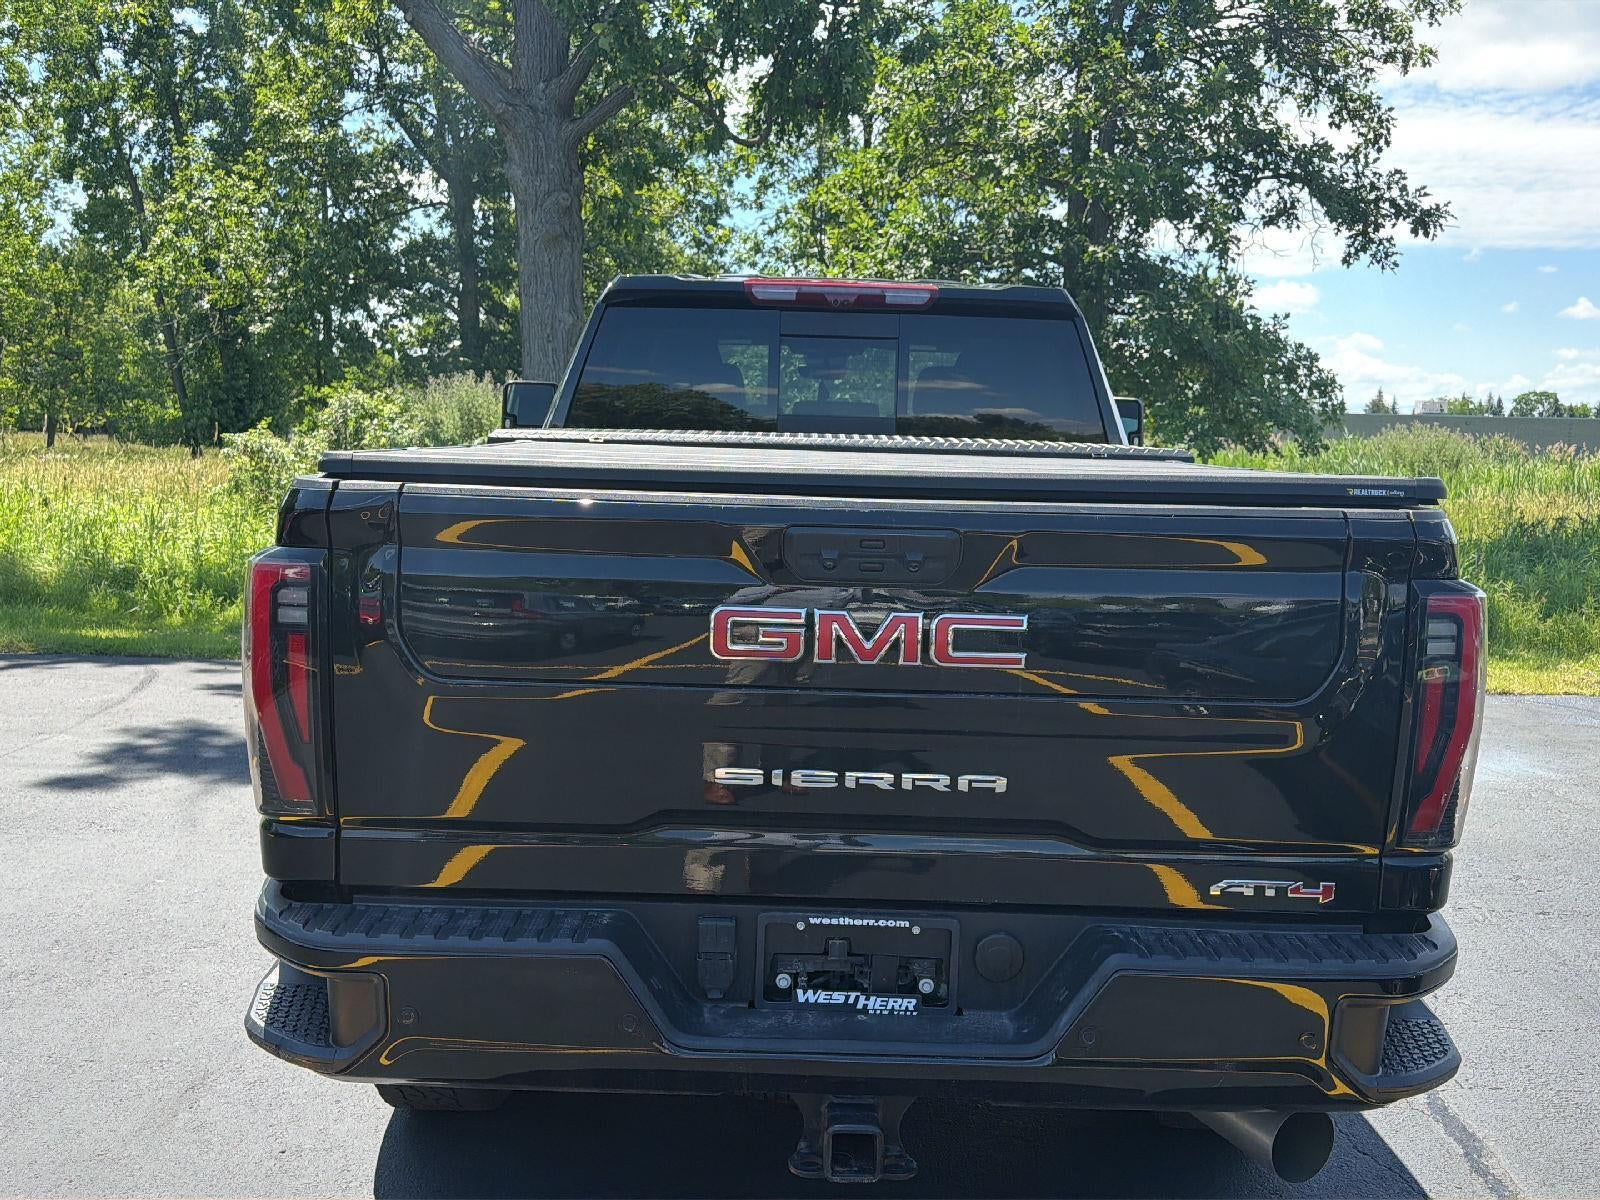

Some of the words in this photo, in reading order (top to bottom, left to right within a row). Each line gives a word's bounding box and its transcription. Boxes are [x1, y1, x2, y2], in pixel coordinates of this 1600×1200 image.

[710, 606, 1028, 669] GMC
[714, 768, 1008, 793] SIERRA
[1209, 879, 1336, 904] AT4
[808, 917, 910, 928] westherr.com
